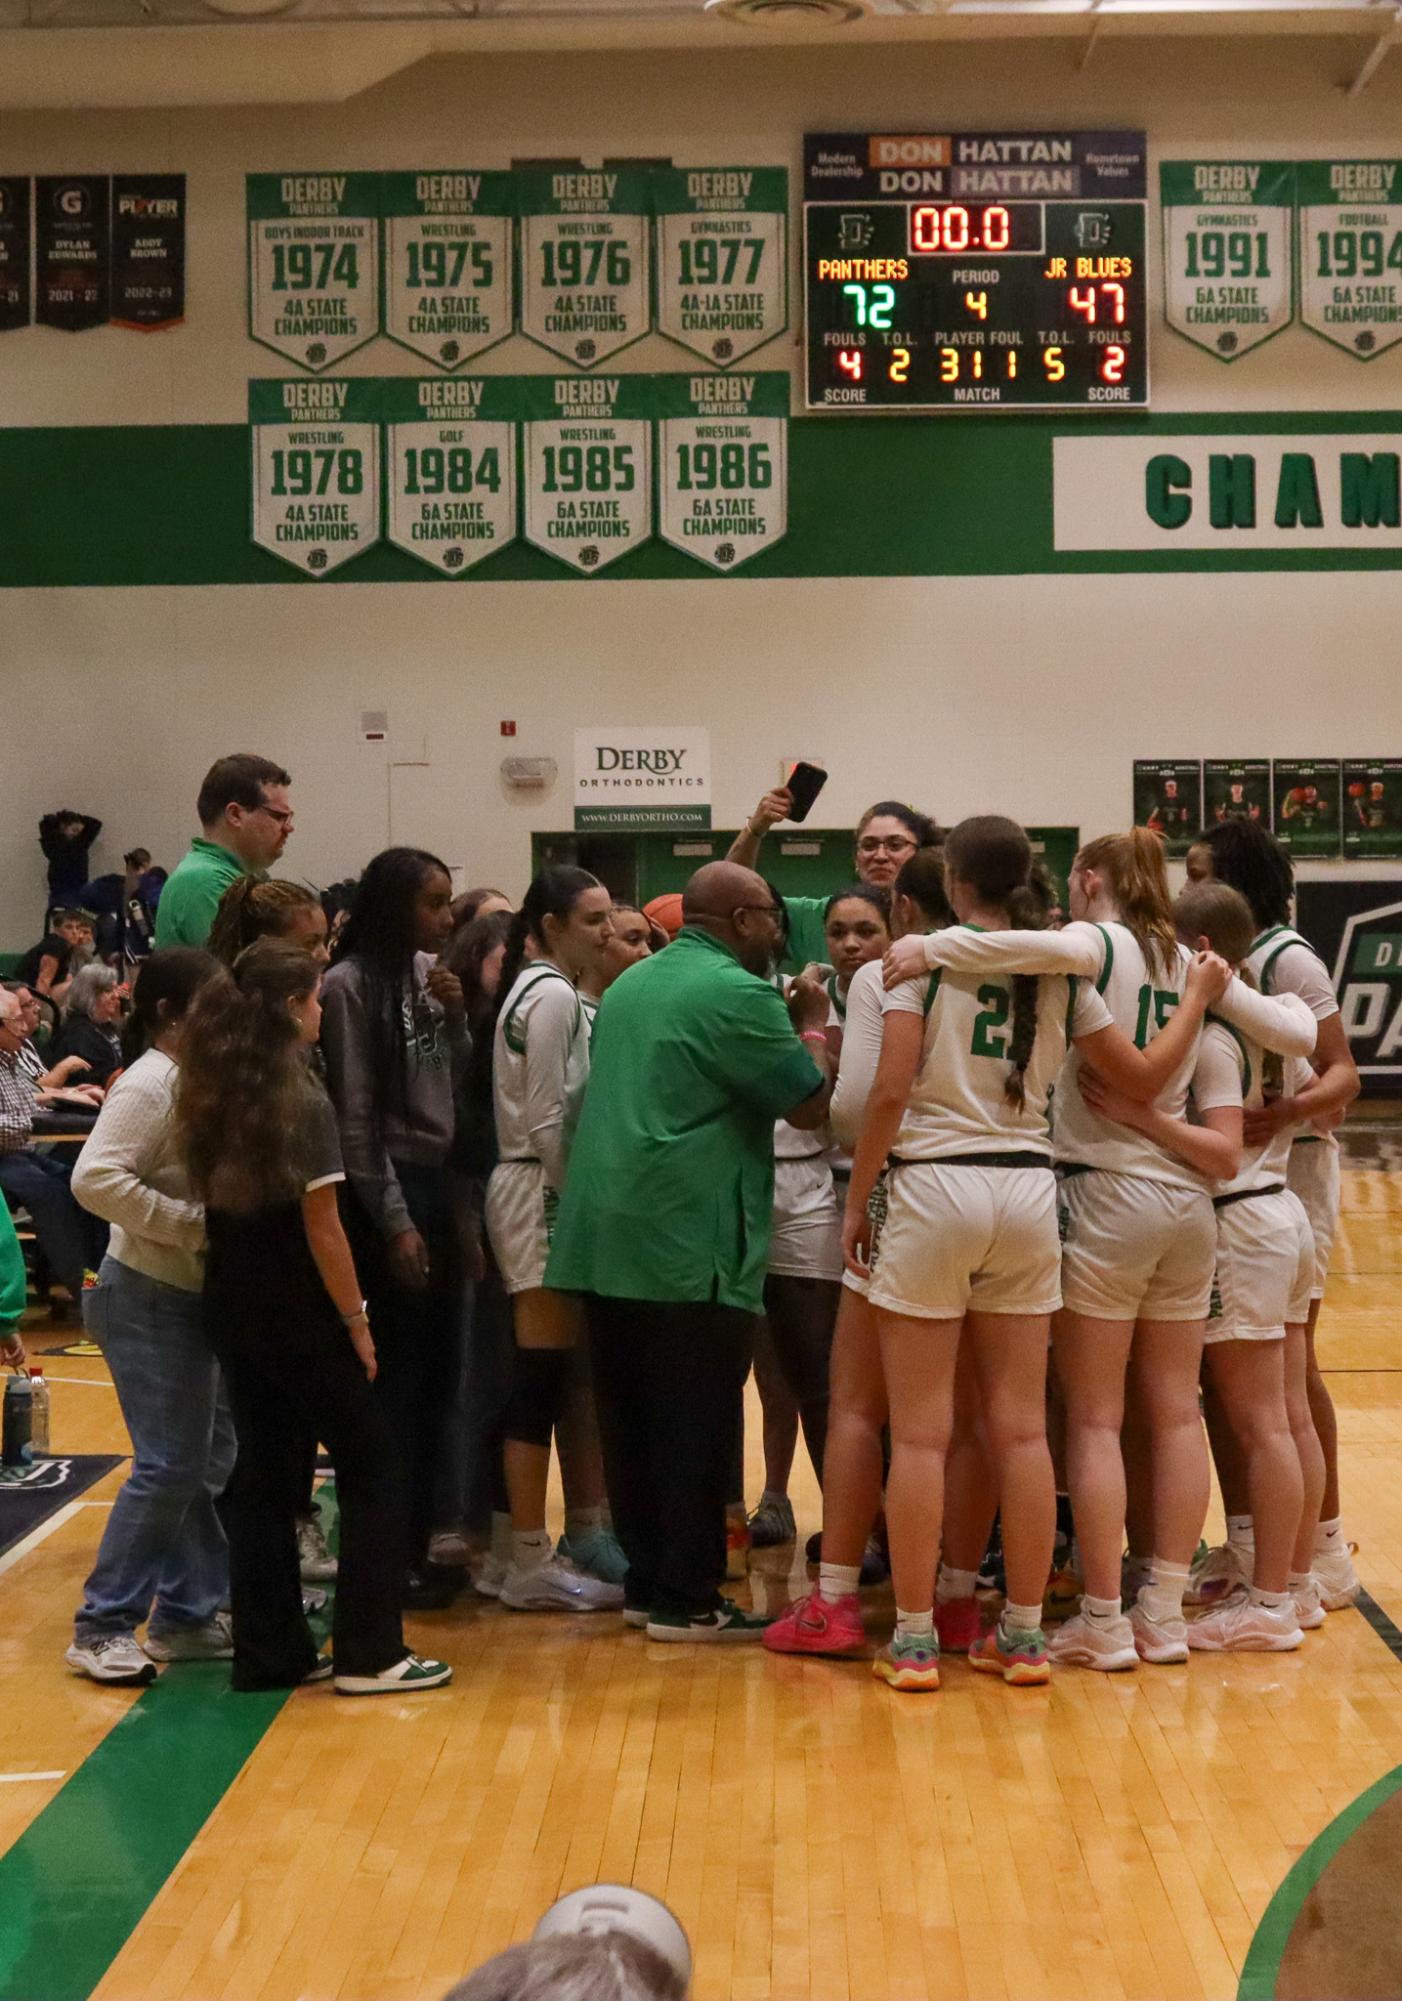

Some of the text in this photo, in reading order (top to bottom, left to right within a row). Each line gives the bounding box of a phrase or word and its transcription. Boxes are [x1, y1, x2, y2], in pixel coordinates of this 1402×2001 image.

[818, 153, 855, 163] Modern
[879, 141, 1072, 162] DON HATTAN
[811, 166, 863, 178] Dealership
[880, 170, 1072, 192] DON HATTAN
[1194, 166, 1260, 190] DERBY
[1331, 165, 1396, 189] DERBY
[281, 177, 346, 201] DERBY
[416, 176, 481, 200] DERBY
[553, 175, 617, 198] DERBY
[687, 173, 752, 197] DERBY
[61, 191, 82, 214] G
[290, 202, 338, 215] PANTHERS
[425, 201, 473, 214] PANTHERS
[561, 200, 609, 212] PANTHERS
[696, 198, 745, 210] PANTHERS
[691, 221, 751, 234] GYMNASTICS
[1197, 214, 1257, 226] GYMNASTICS
[1339, 213, 1388, 225] FOOTBALL
[265, 226, 364, 239] BOYS INDOOR TRACK
[421, 224, 476, 237] WRESTLING
[557, 222, 613, 235] WRESTLING
[914, 207, 1009, 250] 00.0
[130, 249, 167, 259] BROWN
[540, 240, 631, 286] 1976
[678, 239, 765, 285] 1977
[1185, 232, 1270, 277] 1991
[272, 244, 359, 290] 1974
[406, 242, 492, 288] 1975
[818, 259, 909, 279] PANTHERS
[1045, 257, 1131, 278] JR BLUES
[953, 270, 999, 284] PERIOD
[554, 295, 617, 312] 4A STATE
[681, 293, 764, 312] 4A-1A STATE
[1069, 283, 1124, 324] 47
[1196, 287, 1258, 304] 6A STATE
[1333, 286, 1396, 303] 6A STATE
[284, 299, 347, 317] 4A STATE
[418, 297, 479, 315] 4A STATE
[843, 285, 895, 328] 72
[966, 291, 987, 320] 4
[545, 315, 626, 332] CHAMPIONS
[682, 313, 764, 330] CHAMPIONS
[1186, 307, 1269, 323] CHAMPIONS
[274, 318, 357, 336] CHAMPIONS
[408, 316, 490, 334] CHAMPIONS
[824, 332, 866, 346] FOULS
[882, 332, 918, 345] T.O.L.
[935, 331, 1023, 345] PLAYER FOUL
[1037, 331, 1075, 344] T.O.L.
[1088, 331, 1131, 344] FOULS
[839, 351, 861, 380] 4
[889, 348, 910, 382] 2
[941, 348, 982, 381] 31
[1008, 350, 1016, 378] 1
[1044, 347, 1065, 381] 5
[1103, 346, 1125, 380] 2
[283, 383, 348, 407] DERBY
[419, 382, 484, 406] DERBY
[555, 380, 620, 405] DERBY
[690, 377, 756, 402] DERBY
[824, 388, 867, 402] SCORE
[954, 388, 1000, 401] MATCH
[1088, 387, 1130, 400] SCORE
[291, 408, 340, 421] PANTHERS
[427, 407, 476, 419] PANTHERS
[563, 405, 612, 417] PANTHERS
[699, 402, 748, 415] PANTHERS
[289, 432, 344, 444] WRESTLING
[440, 431, 464, 443] GOLF
[560, 428, 616, 441] WRESTLING
[696, 426, 752, 439] WRESTLING
[271, 449, 363, 495] 1978
[404, 448, 501, 494] 1984
[542, 446, 634, 492] 1985
[677, 444, 772, 490] 1986
[1146, 452, 1402, 529] CHAM
[286, 505, 348, 522] 4A STATE
[422, 503, 484, 521] 6A STATE
[557, 501, 620, 518] 6A STATE
[693, 498, 755, 516] 6A STATE
[276, 524, 358, 541] CHAMPIONS
[412, 522, 494, 540] CHAMPIONS
[547, 521, 630, 538] CHAMPIONS
[683, 518, 766, 536] CHAMPIONS
[596, 747, 687, 775] DERBY
[580, 778, 703, 788] ORTHODONTICS
